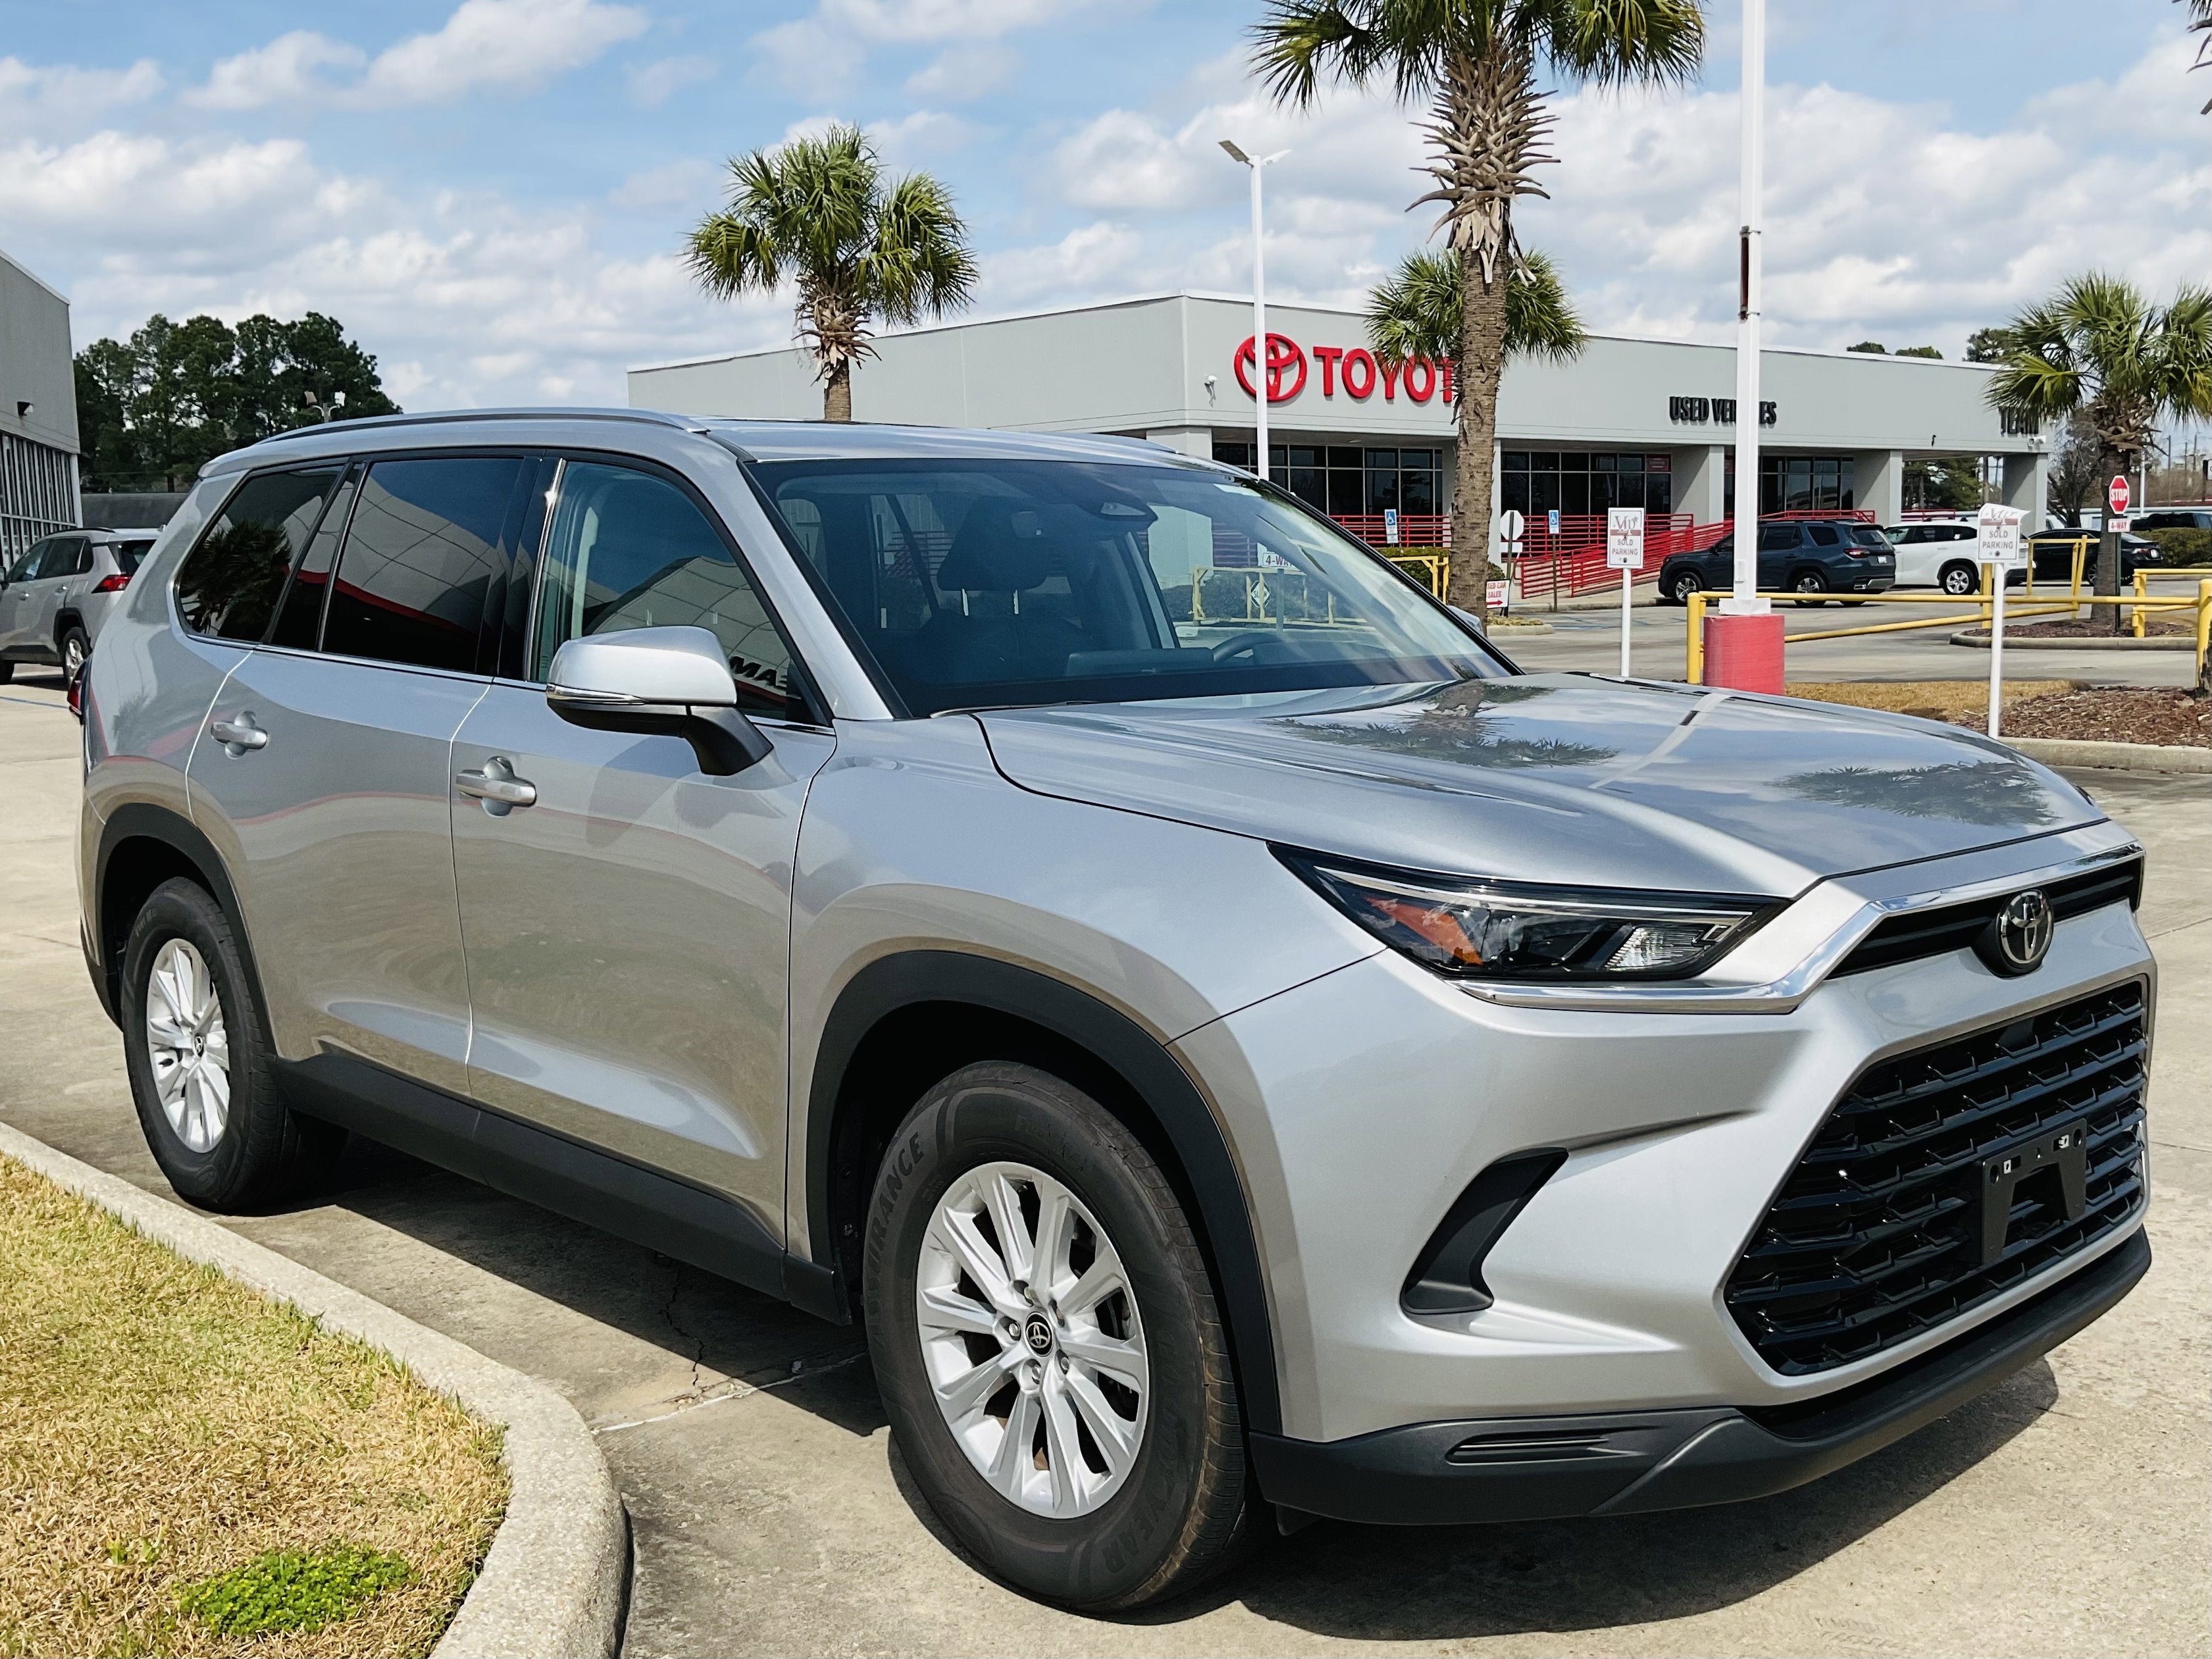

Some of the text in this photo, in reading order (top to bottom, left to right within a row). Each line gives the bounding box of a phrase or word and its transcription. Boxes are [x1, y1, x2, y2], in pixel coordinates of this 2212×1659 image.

[1313, 346, 1456, 403] TOYOT
[1669, 396, 1777, 424] USED VEHES
[2111, 488, 2128, 501] STOP
[2111, 521, 2127, 530] 4-WAY
[1266, 555, 1292, 567] 4-WA
